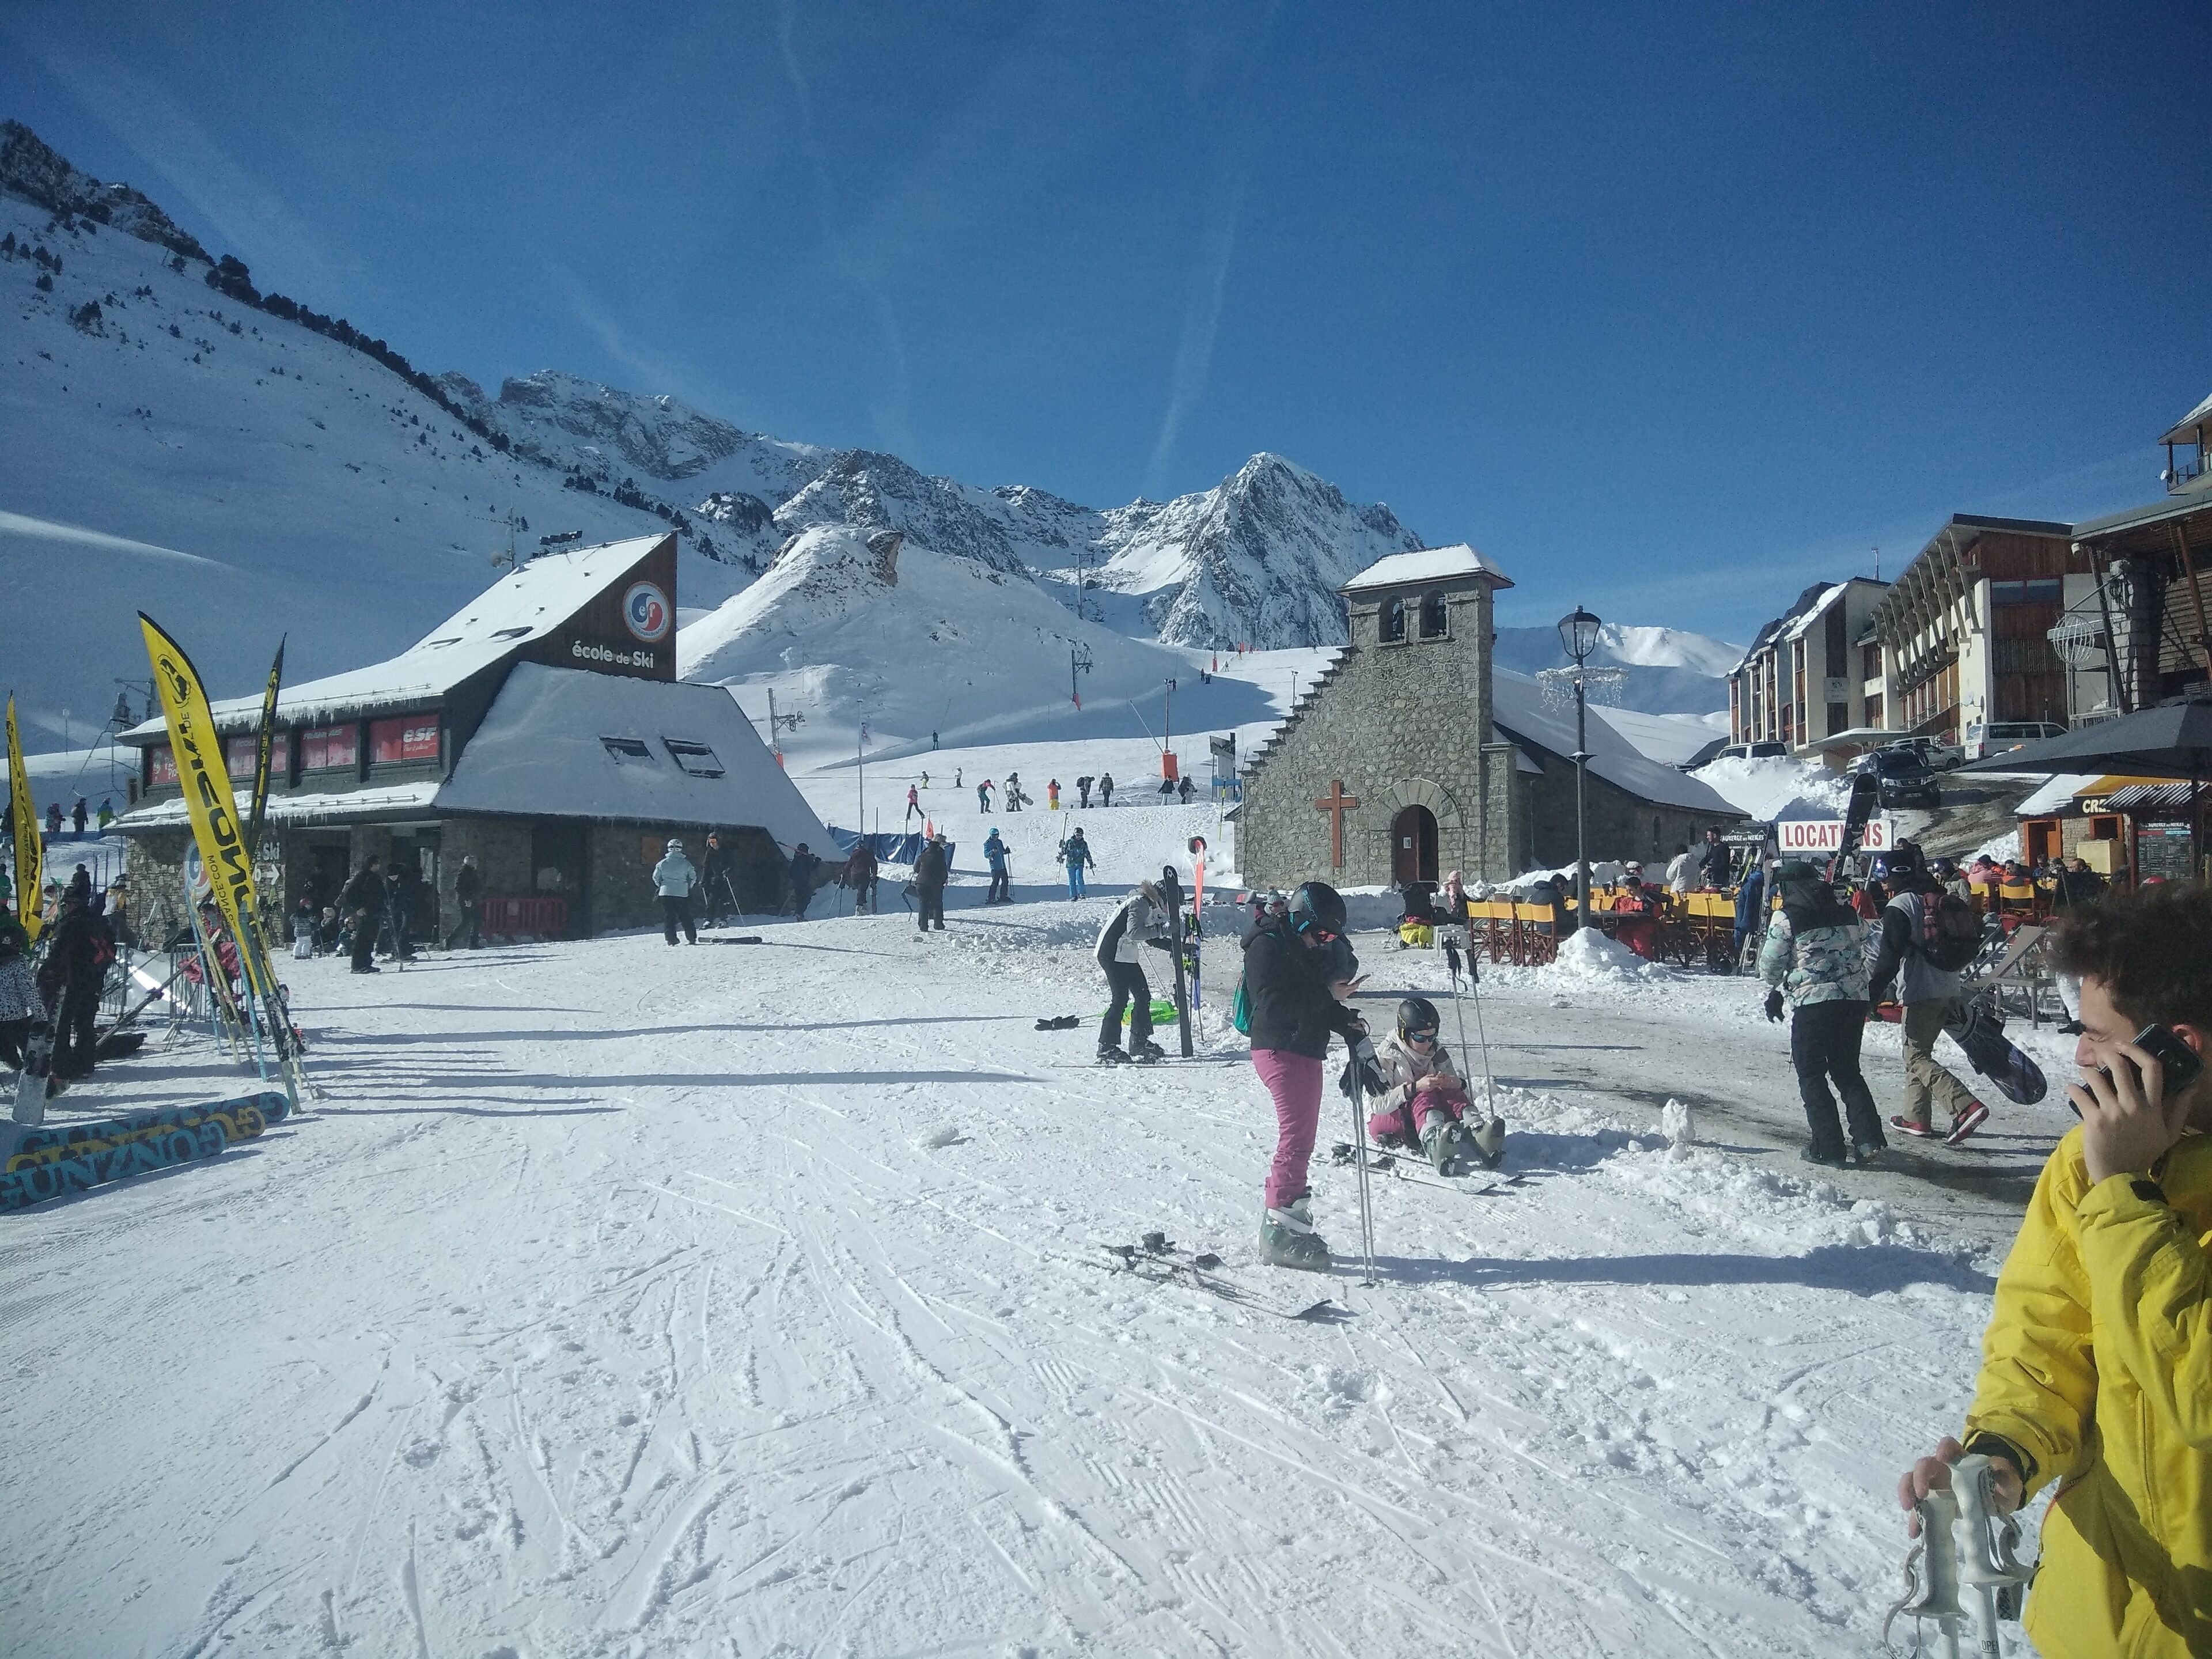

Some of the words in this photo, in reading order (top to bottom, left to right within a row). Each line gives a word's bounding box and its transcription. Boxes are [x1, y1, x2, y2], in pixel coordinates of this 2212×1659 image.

[572, 640, 613, 662] école
[616, 653, 630, 665] de
[632, 651, 654, 669] Ski
[1785, 823, 1883, 847] LOCATINS
